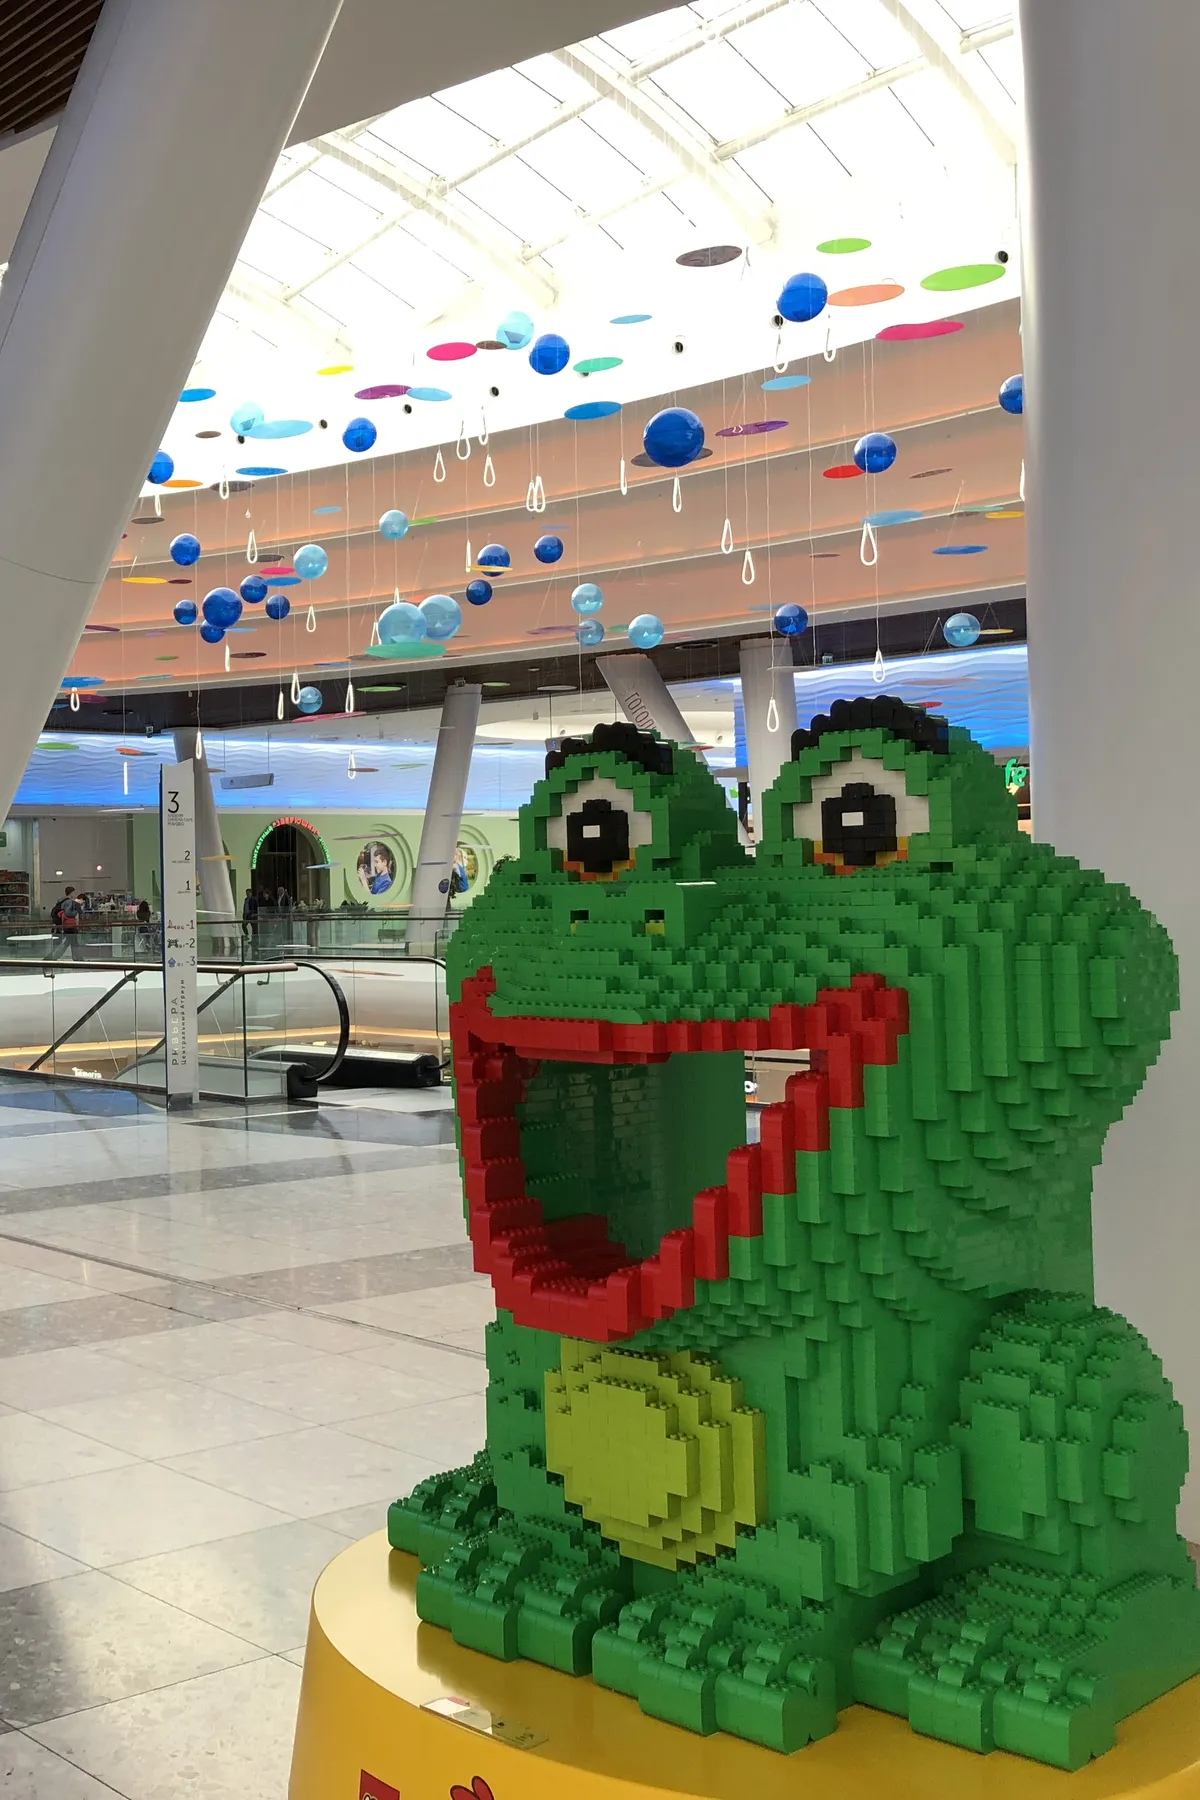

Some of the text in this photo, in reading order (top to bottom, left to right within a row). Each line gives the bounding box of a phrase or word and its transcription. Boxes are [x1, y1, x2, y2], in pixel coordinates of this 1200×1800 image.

[625, 692, 657, 729] ГОГОЛ
[168, 791, 180, 813] 3
[184, 850, 191, 860] 2
[186, 880, 191, 890] 1
